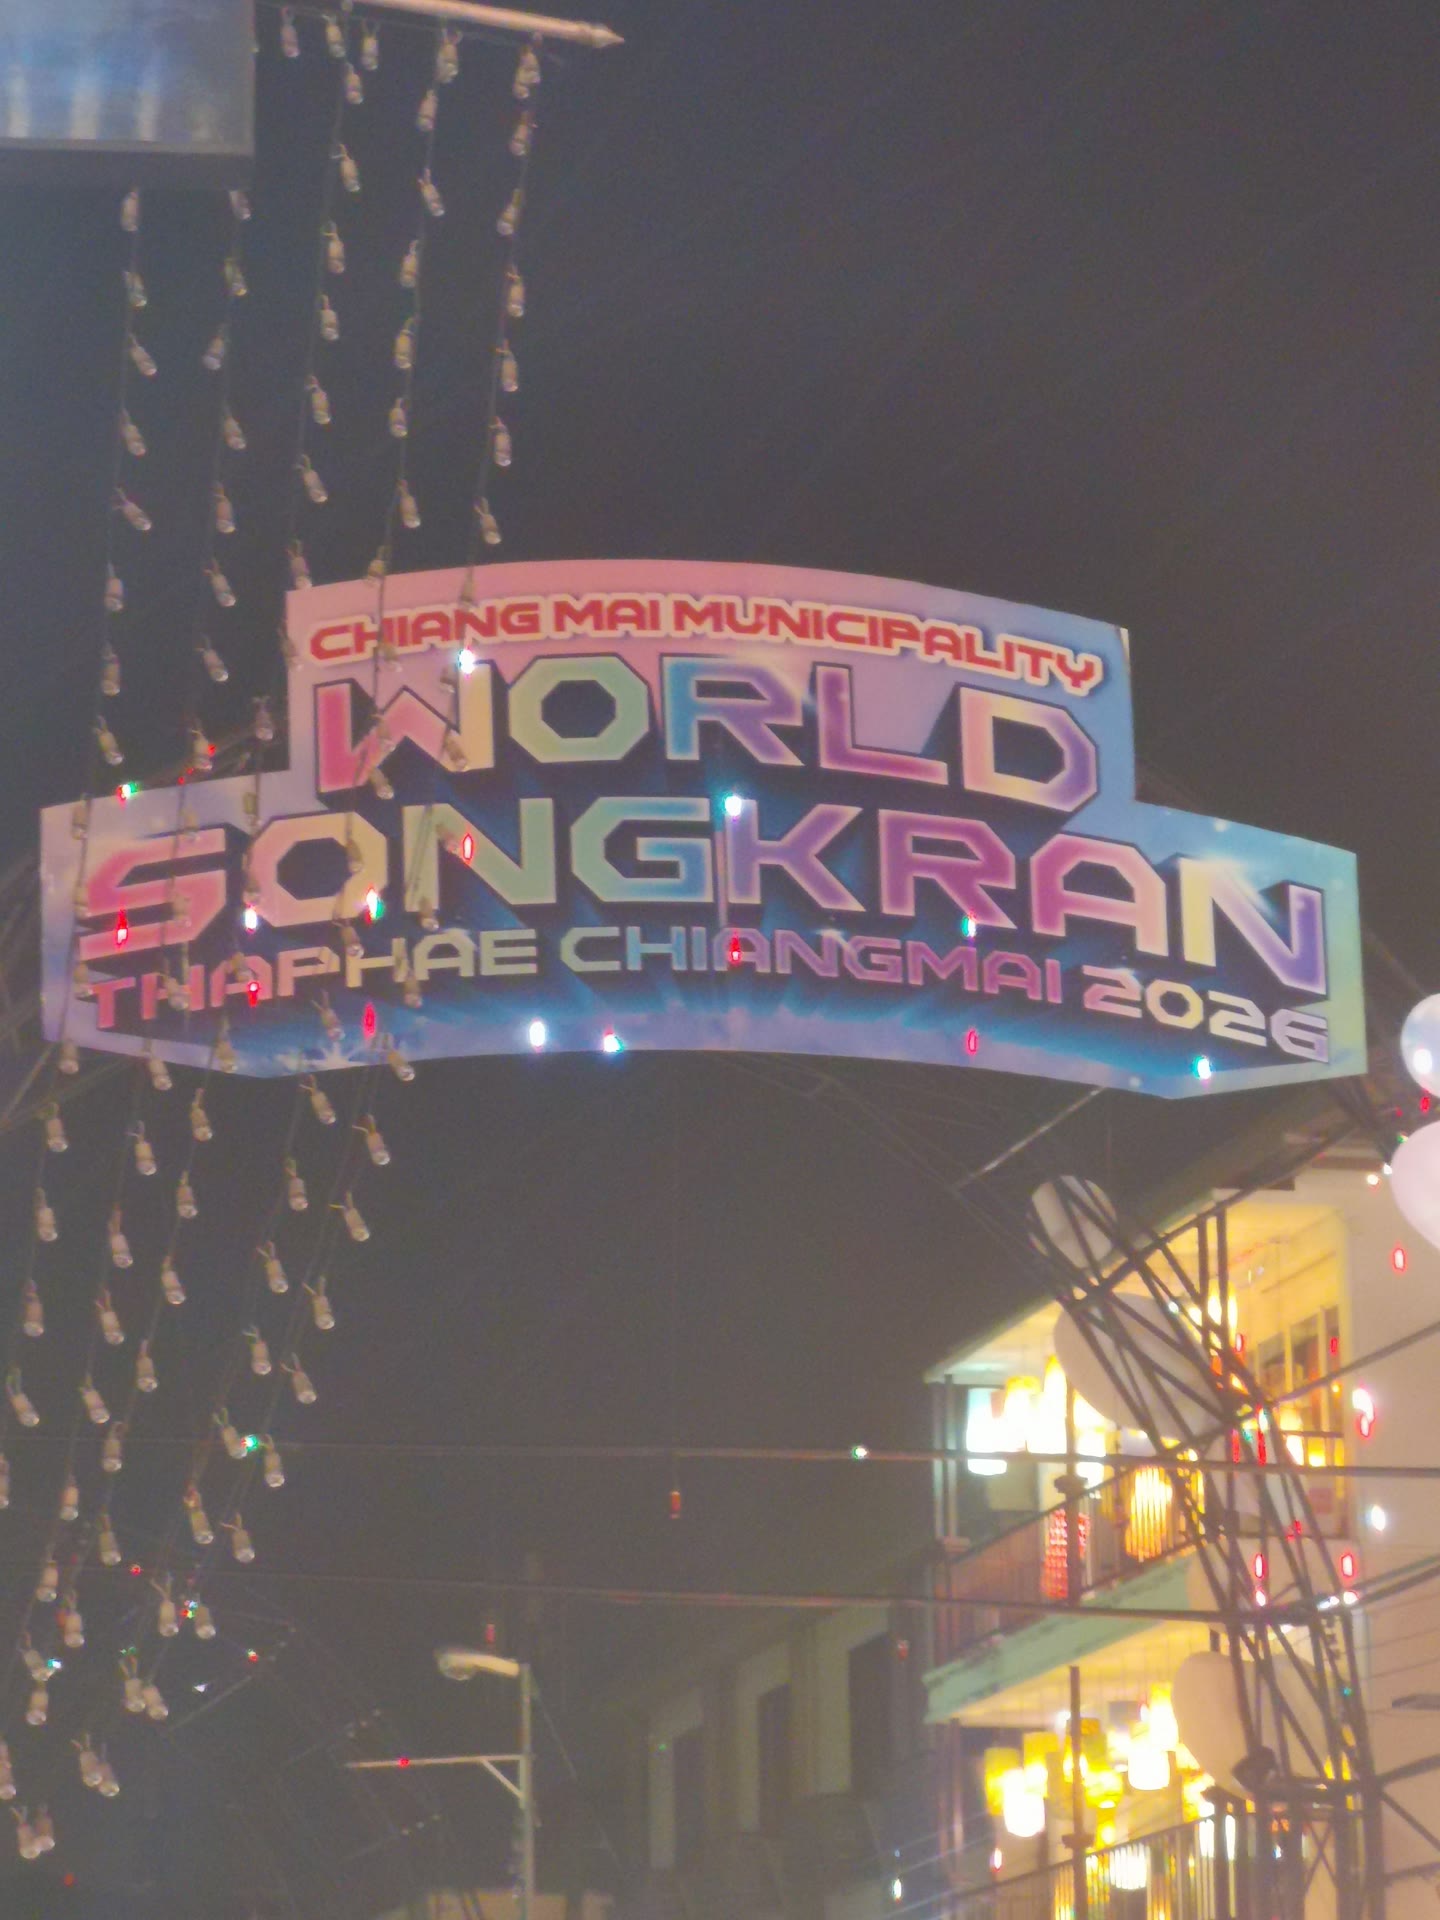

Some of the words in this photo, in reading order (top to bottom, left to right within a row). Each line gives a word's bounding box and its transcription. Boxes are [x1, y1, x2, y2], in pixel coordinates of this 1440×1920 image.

[310, 602, 540, 661] CHIANG
[555, 598, 661, 634] MAI
[673, 599, 1104, 691] MUNICIPALITY
[316, 654, 1098, 813] WORLD
[78, 795, 1326, 997] SONGKRAN
[88, 930, 539, 1029] THAPHAE
[1082, 965, 1330, 1065] 2026
